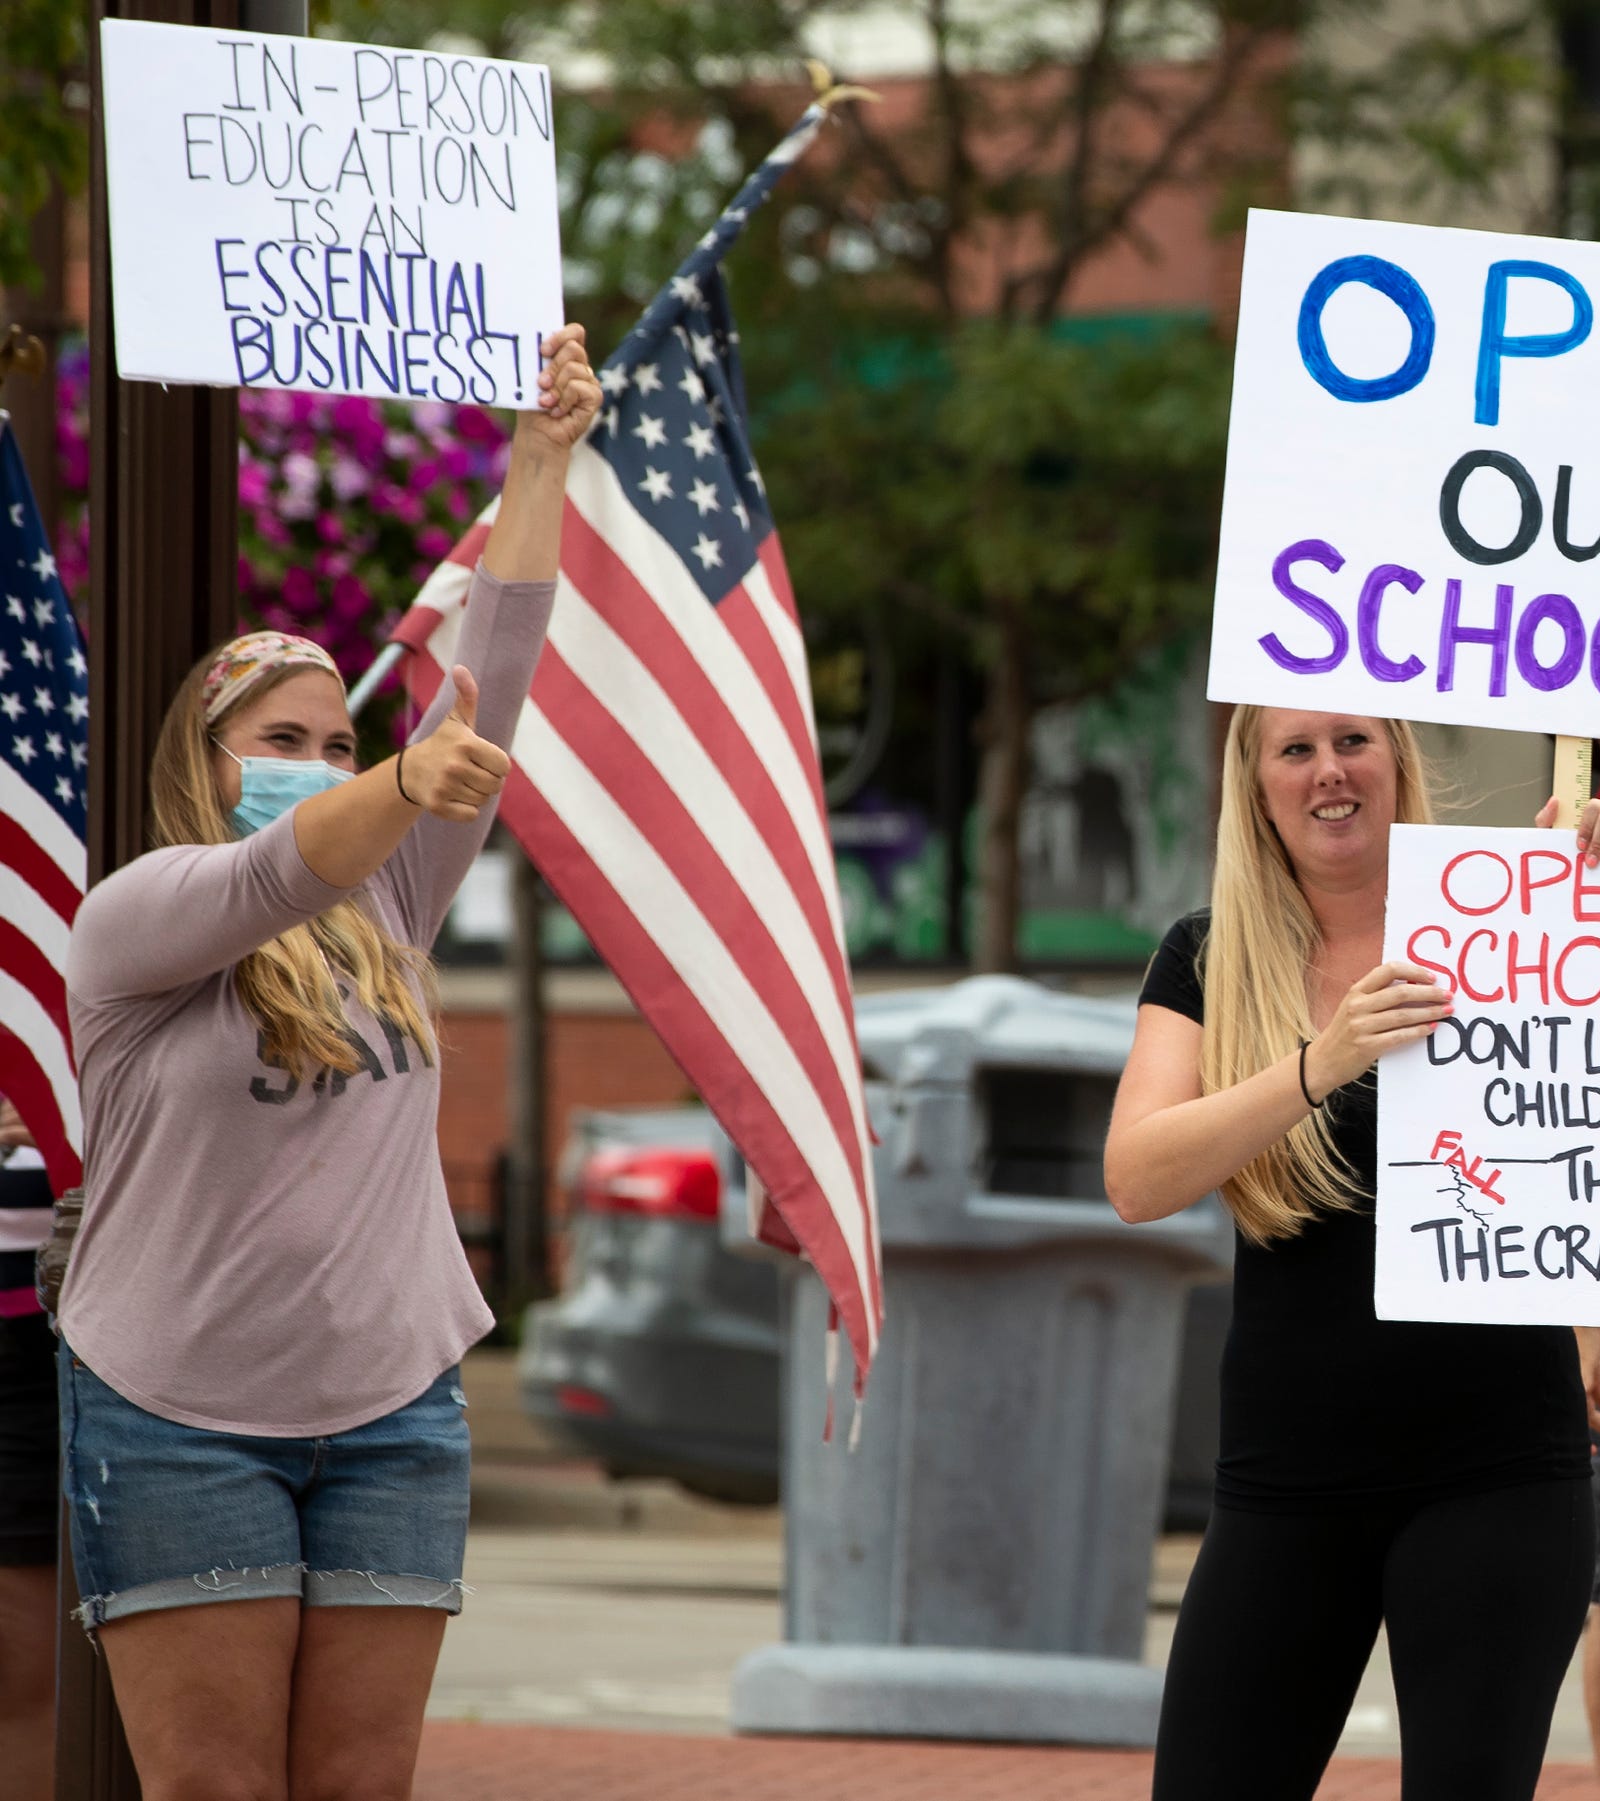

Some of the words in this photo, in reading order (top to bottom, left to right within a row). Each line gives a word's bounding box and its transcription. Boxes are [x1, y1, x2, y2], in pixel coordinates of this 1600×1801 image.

[217, 40, 550, 141] IN-PERSON
[183, 112, 516, 212] EDUCATION
[274, 197, 340, 249] IS
[360, 202, 427, 259] AN
[215, 238, 519, 340] ESSENTIAL
[1426, 1016, 1571, 1072] DON'T
[1430, 1130, 1506, 1205] FALL
[1411, 1217, 1529, 1283] THE
